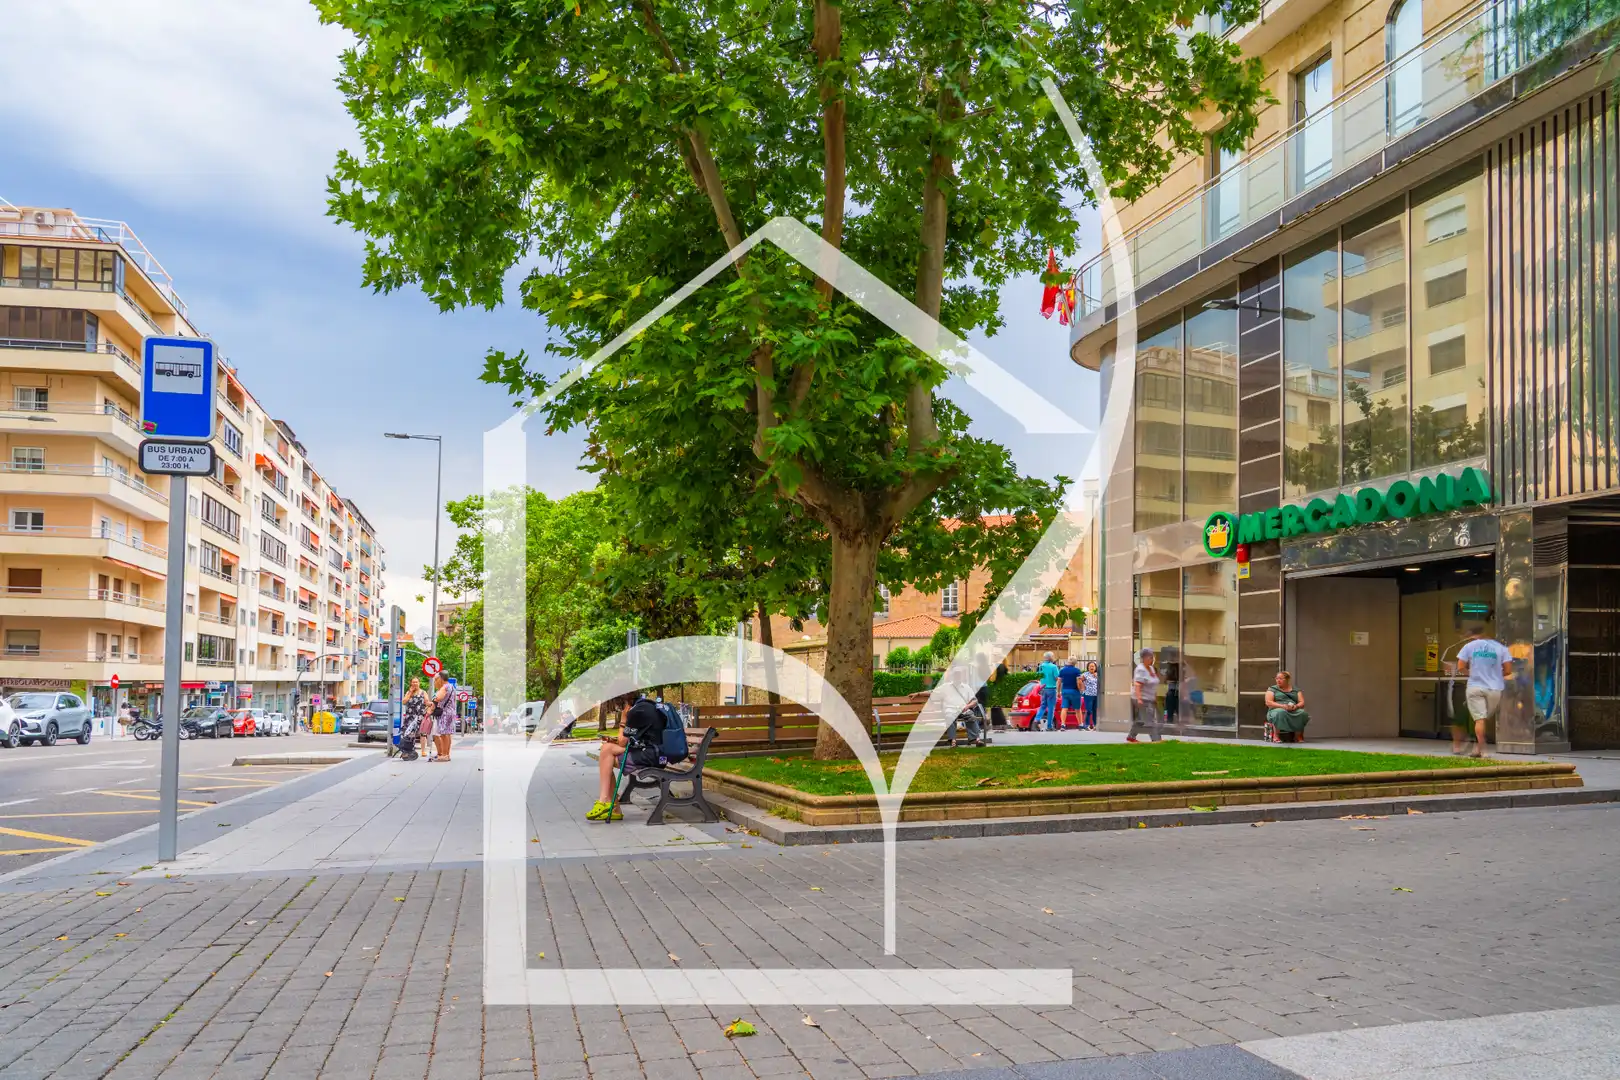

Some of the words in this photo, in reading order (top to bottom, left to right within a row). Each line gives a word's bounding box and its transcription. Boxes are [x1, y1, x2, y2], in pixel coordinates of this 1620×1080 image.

[147, 445, 166, 453] BUS
[168, 446, 207, 455] URBANO
[158, 454, 170, 462] DE
[1237, 466, 1492, 545] MERCADONA
